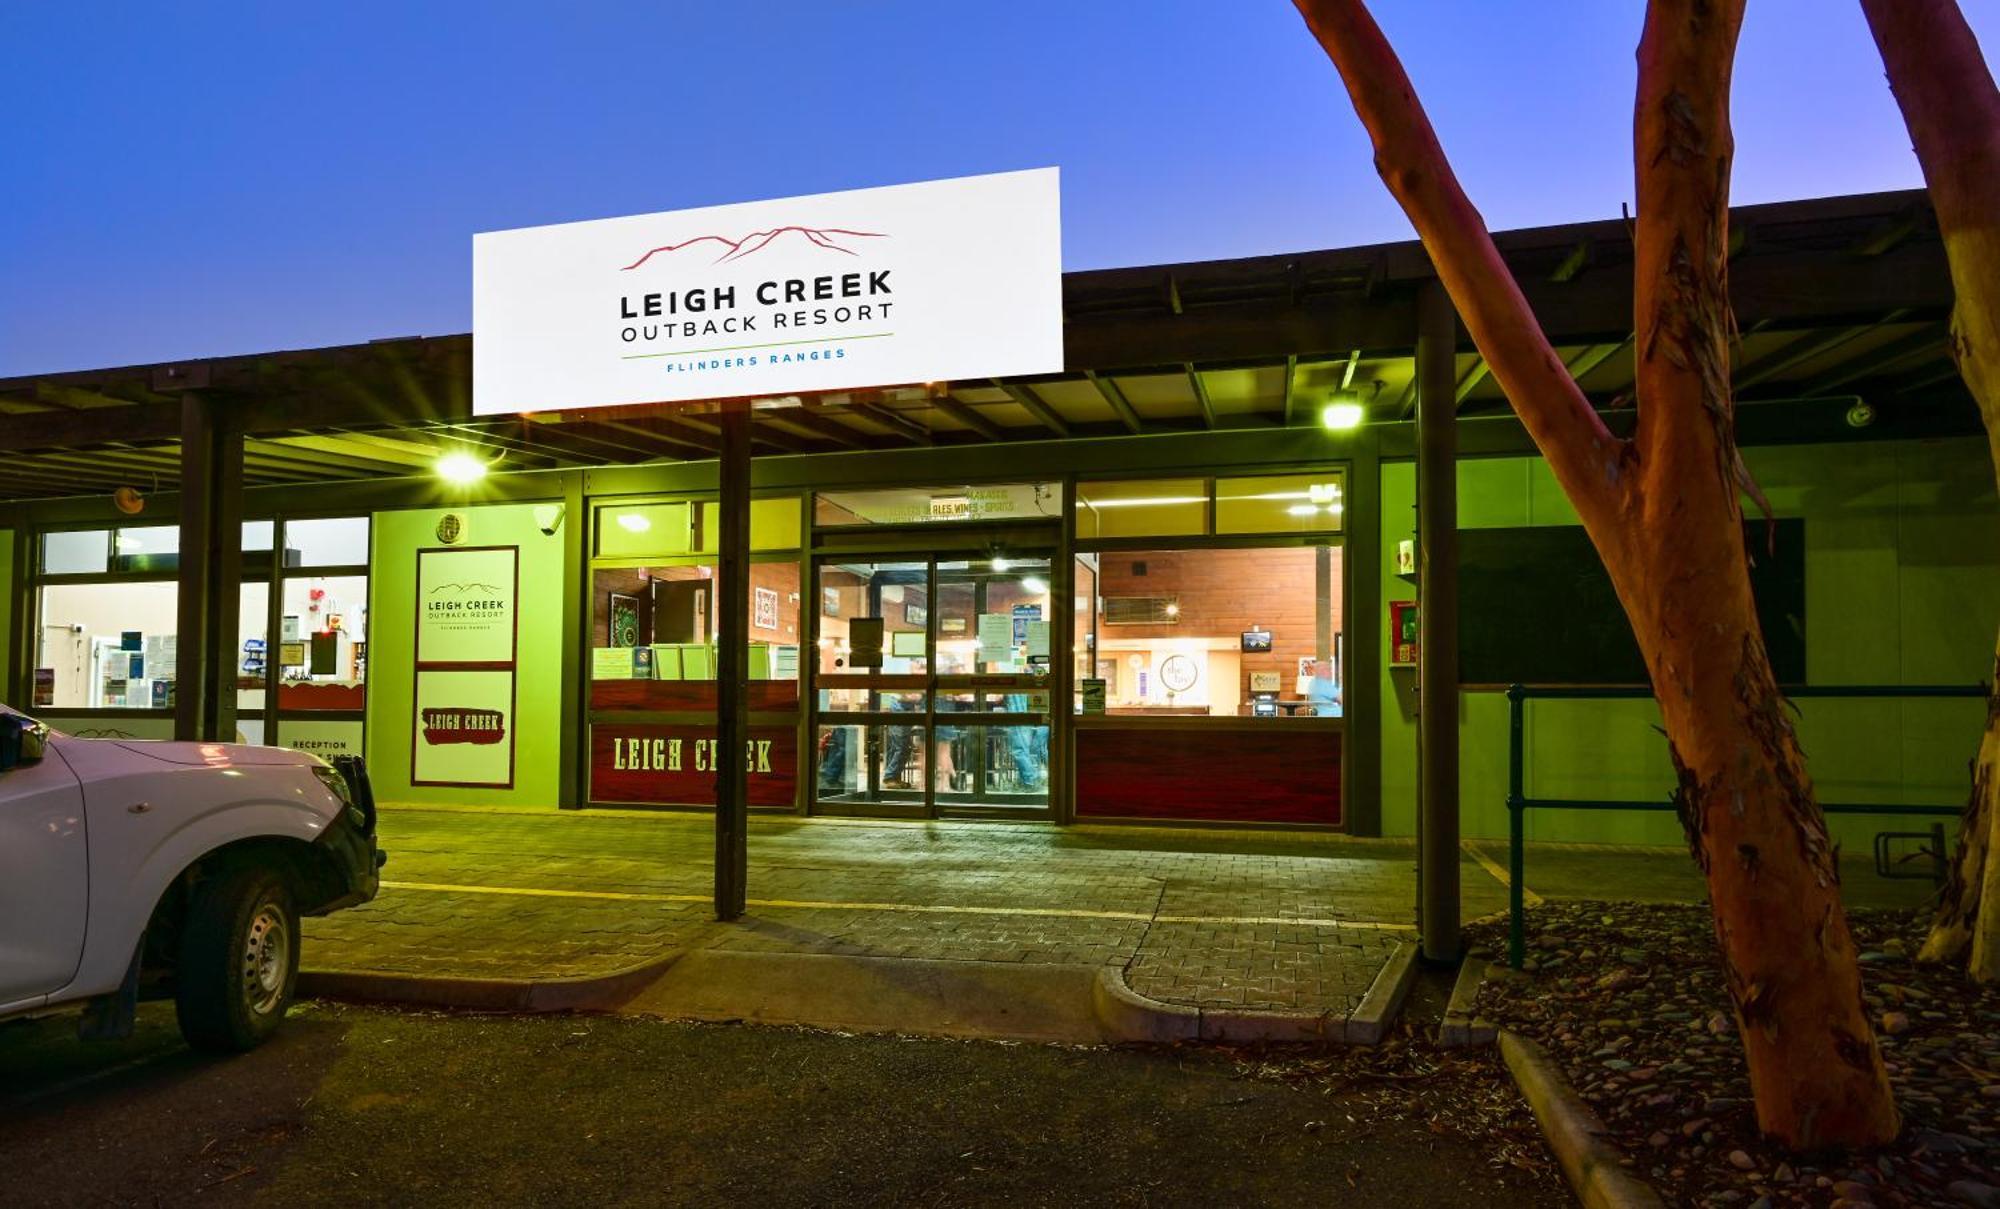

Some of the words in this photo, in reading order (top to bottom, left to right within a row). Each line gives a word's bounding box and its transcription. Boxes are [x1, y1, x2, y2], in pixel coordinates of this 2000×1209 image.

[621, 285, 735, 320] LEIGH
[756, 270, 893, 306] CREEK
[621, 316, 757, 343] OUTBACK
[774, 302, 894, 330] RESORT
[666, 356, 758, 373] FLINDERS
[769, 348, 846, 364] RANGES
[428, 601, 462, 611] LEIGH
[466, 600, 504, 610] CREEK
[428, 611, 467, 620] OUTBACK
[470, 610, 505, 619] RESORT
[429, 713, 460, 730] LEIGH
[464, 714, 498, 731] CREEK
[292, 740, 347, 749] RECEPTION
[613, 737, 682, 772] LEIGH
[695, 738, 772, 773] CEK
